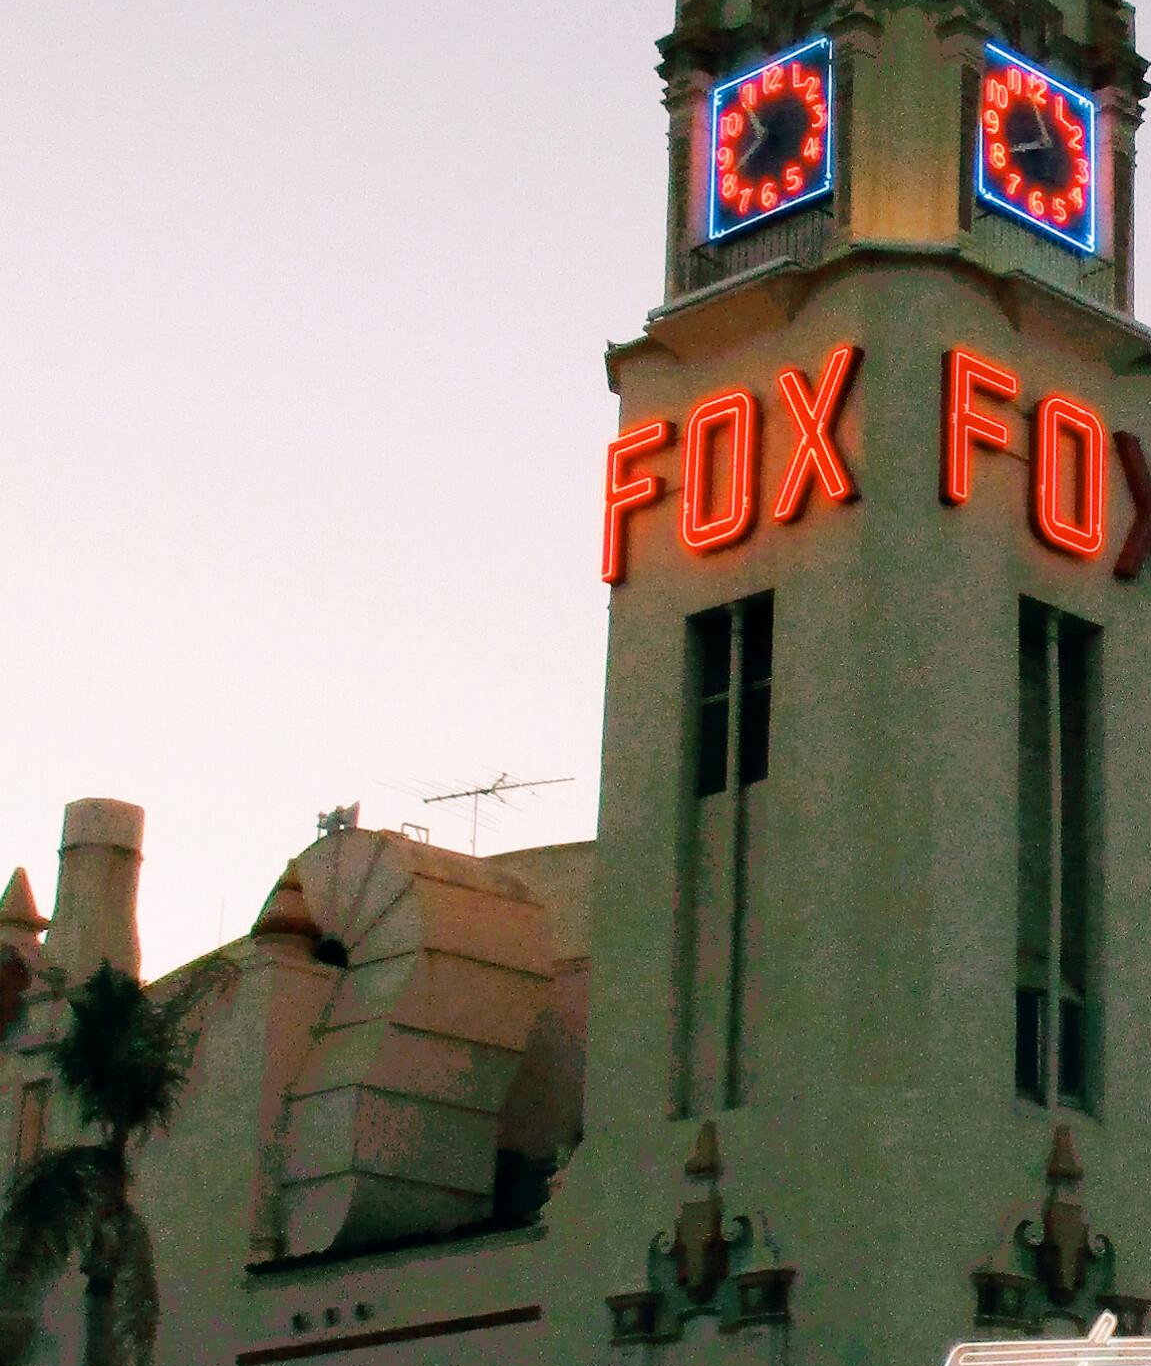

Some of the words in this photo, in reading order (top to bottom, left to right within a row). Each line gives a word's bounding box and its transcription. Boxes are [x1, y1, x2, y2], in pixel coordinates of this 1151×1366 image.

[762, 66, 783, 94] 12
[804, 77, 820, 101] 2
[986, 78, 1008, 109] 10
[720, 112, 743, 140] 10
[811, 104, 825, 128] 3
[984, 110, 999, 133] 9
[803, 137, 821, 159] 4
[1067, 126, 1083, 150] 2
[718, 149, 734, 171] 9
[989, 142, 1006, 169] 8
[785, 166, 801, 191] 5
[1074, 158, 1089, 184] 3
[721, 173, 737, 200] 8
[760, 182, 776, 207] 6
[1008, 173, 1022, 195] 7
[738, 187, 753, 213] 7
[1027, 191, 1045, 215] 6
[1051, 198, 1067, 221] 5
[600, 344, 864, 585] FOX
